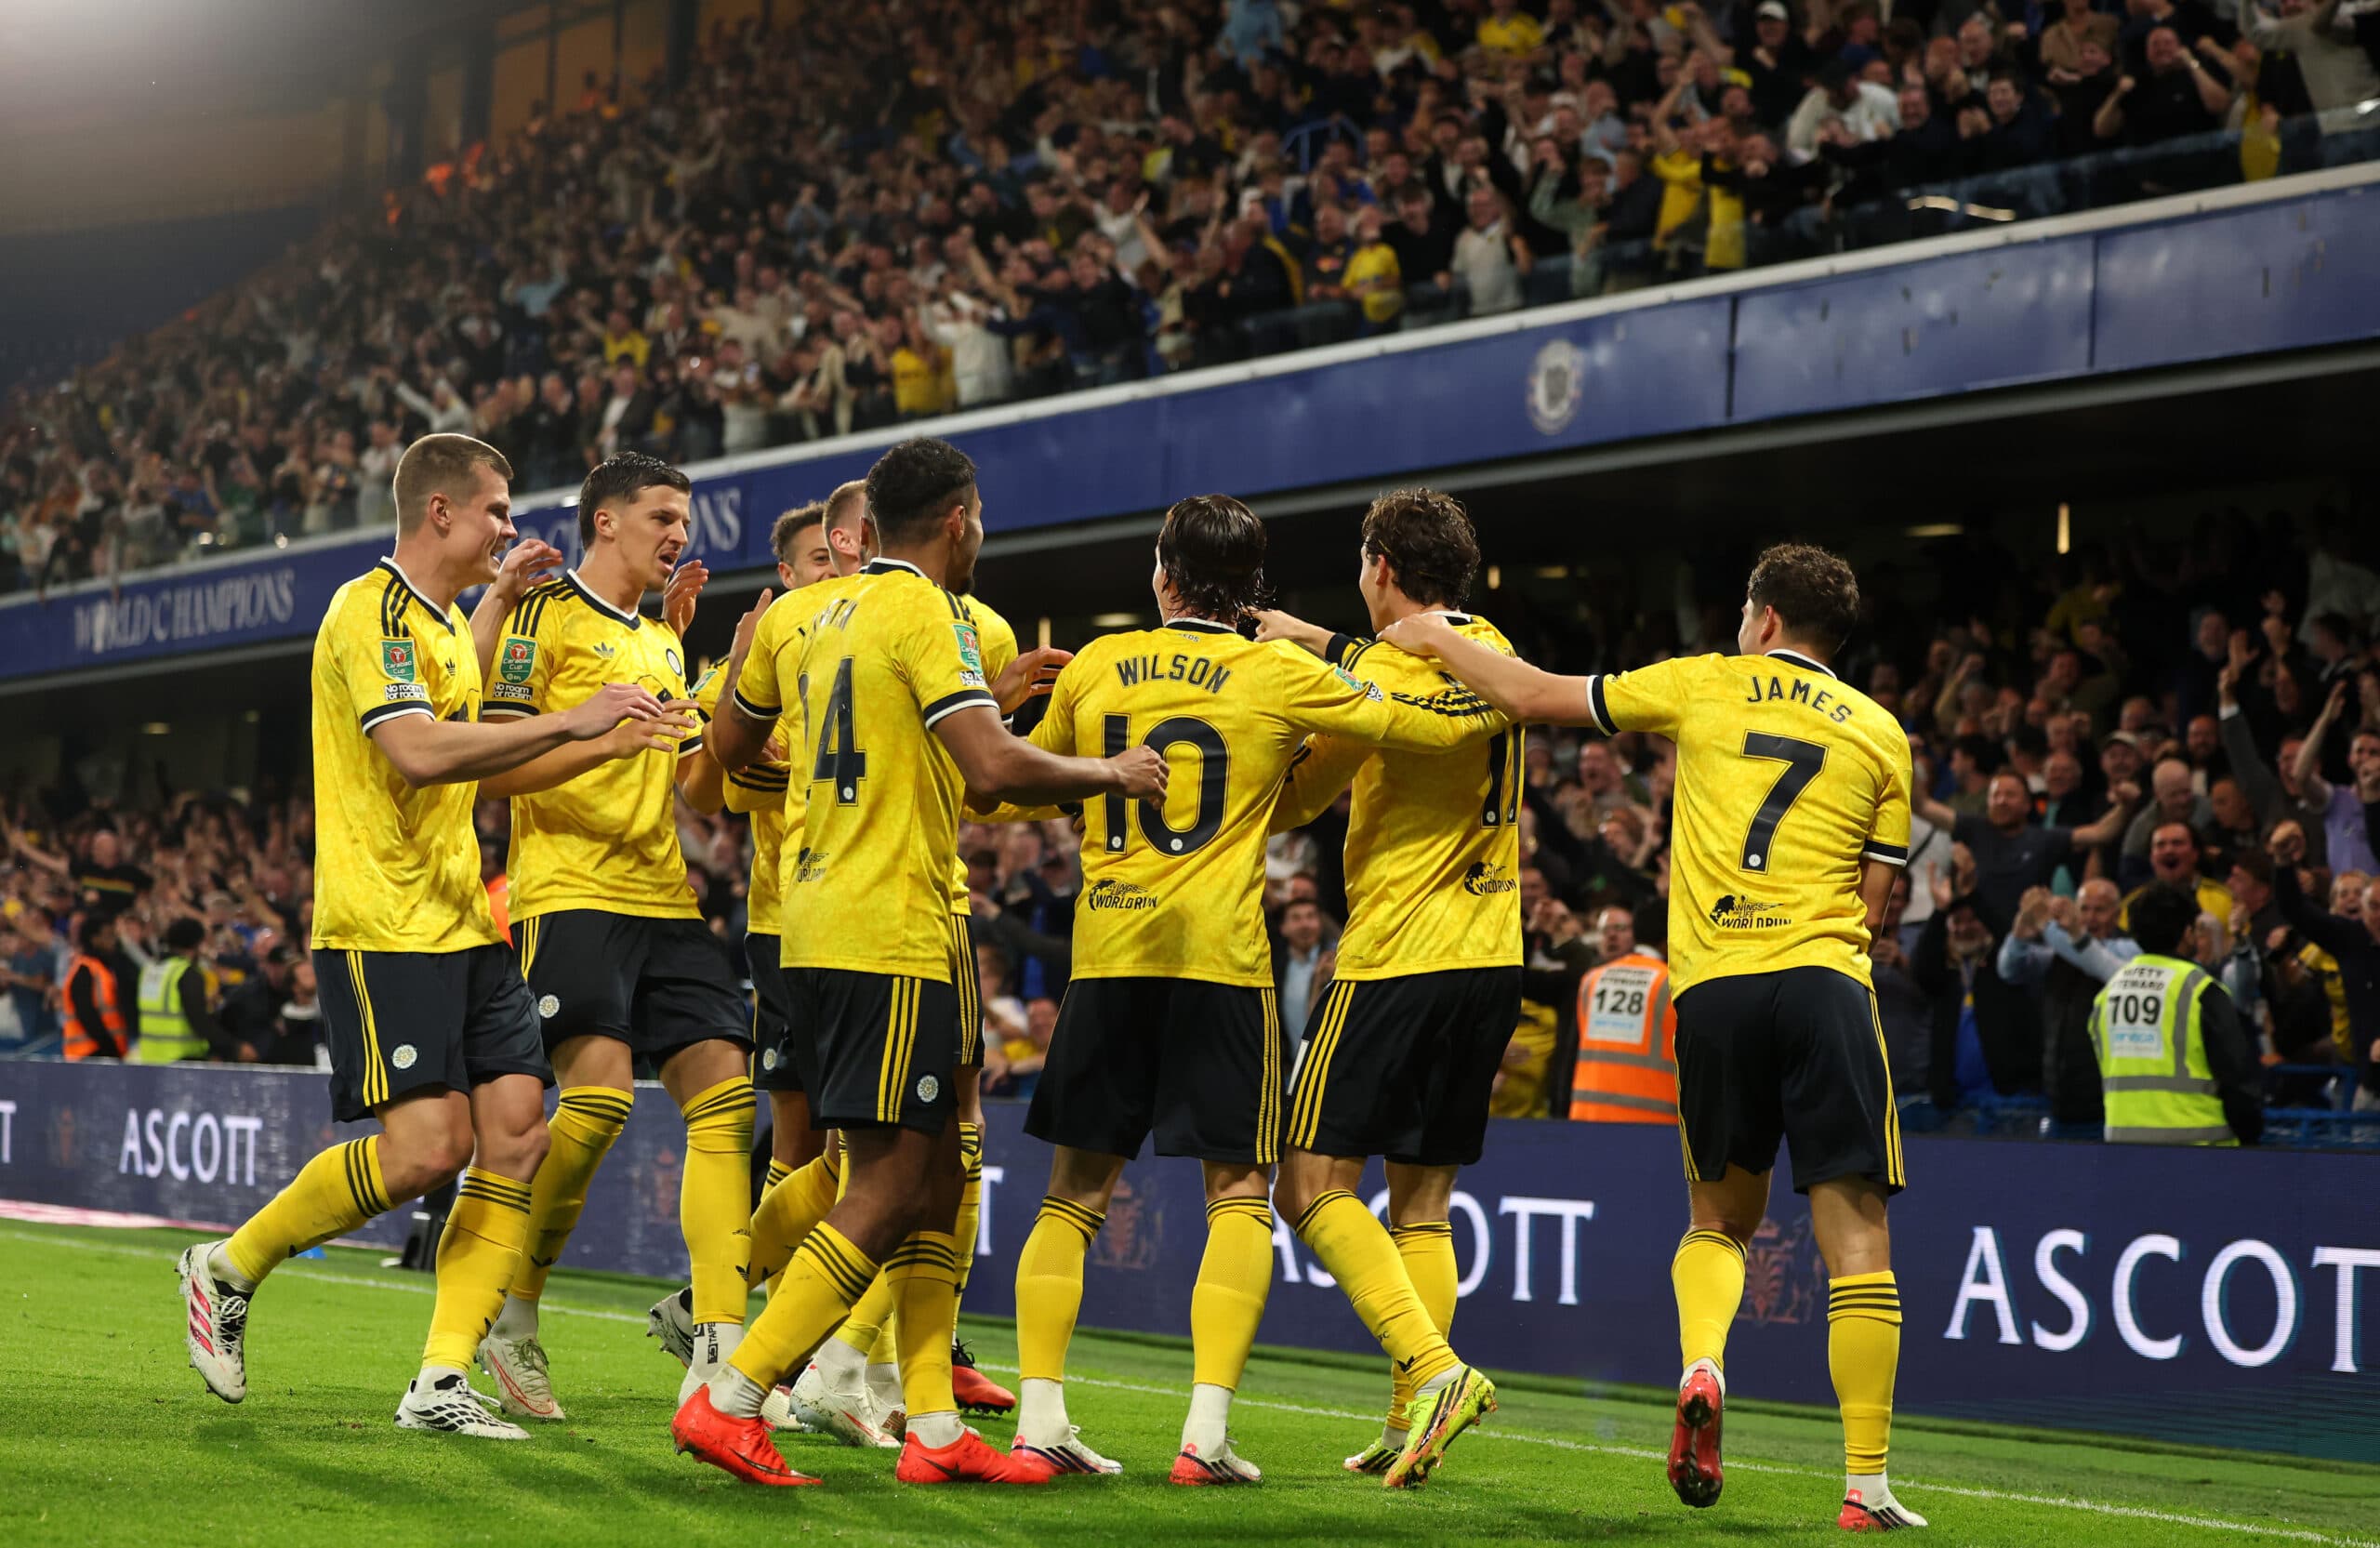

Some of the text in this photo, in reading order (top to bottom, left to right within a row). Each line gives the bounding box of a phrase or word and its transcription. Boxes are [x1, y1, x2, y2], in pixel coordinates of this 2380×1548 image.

[1115, 654, 1233, 695] WILSON
[1746, 675, 1853, 724] JAMES
[1103, 712, 1232, 859] 10
[1739, 729, 1830, 876] 7
[1595, 988, 1644, 1015] 128
[119, 1108, 262, 1187] ASCOTT
[1944, 1225, 2380, 1373] ASCOT
